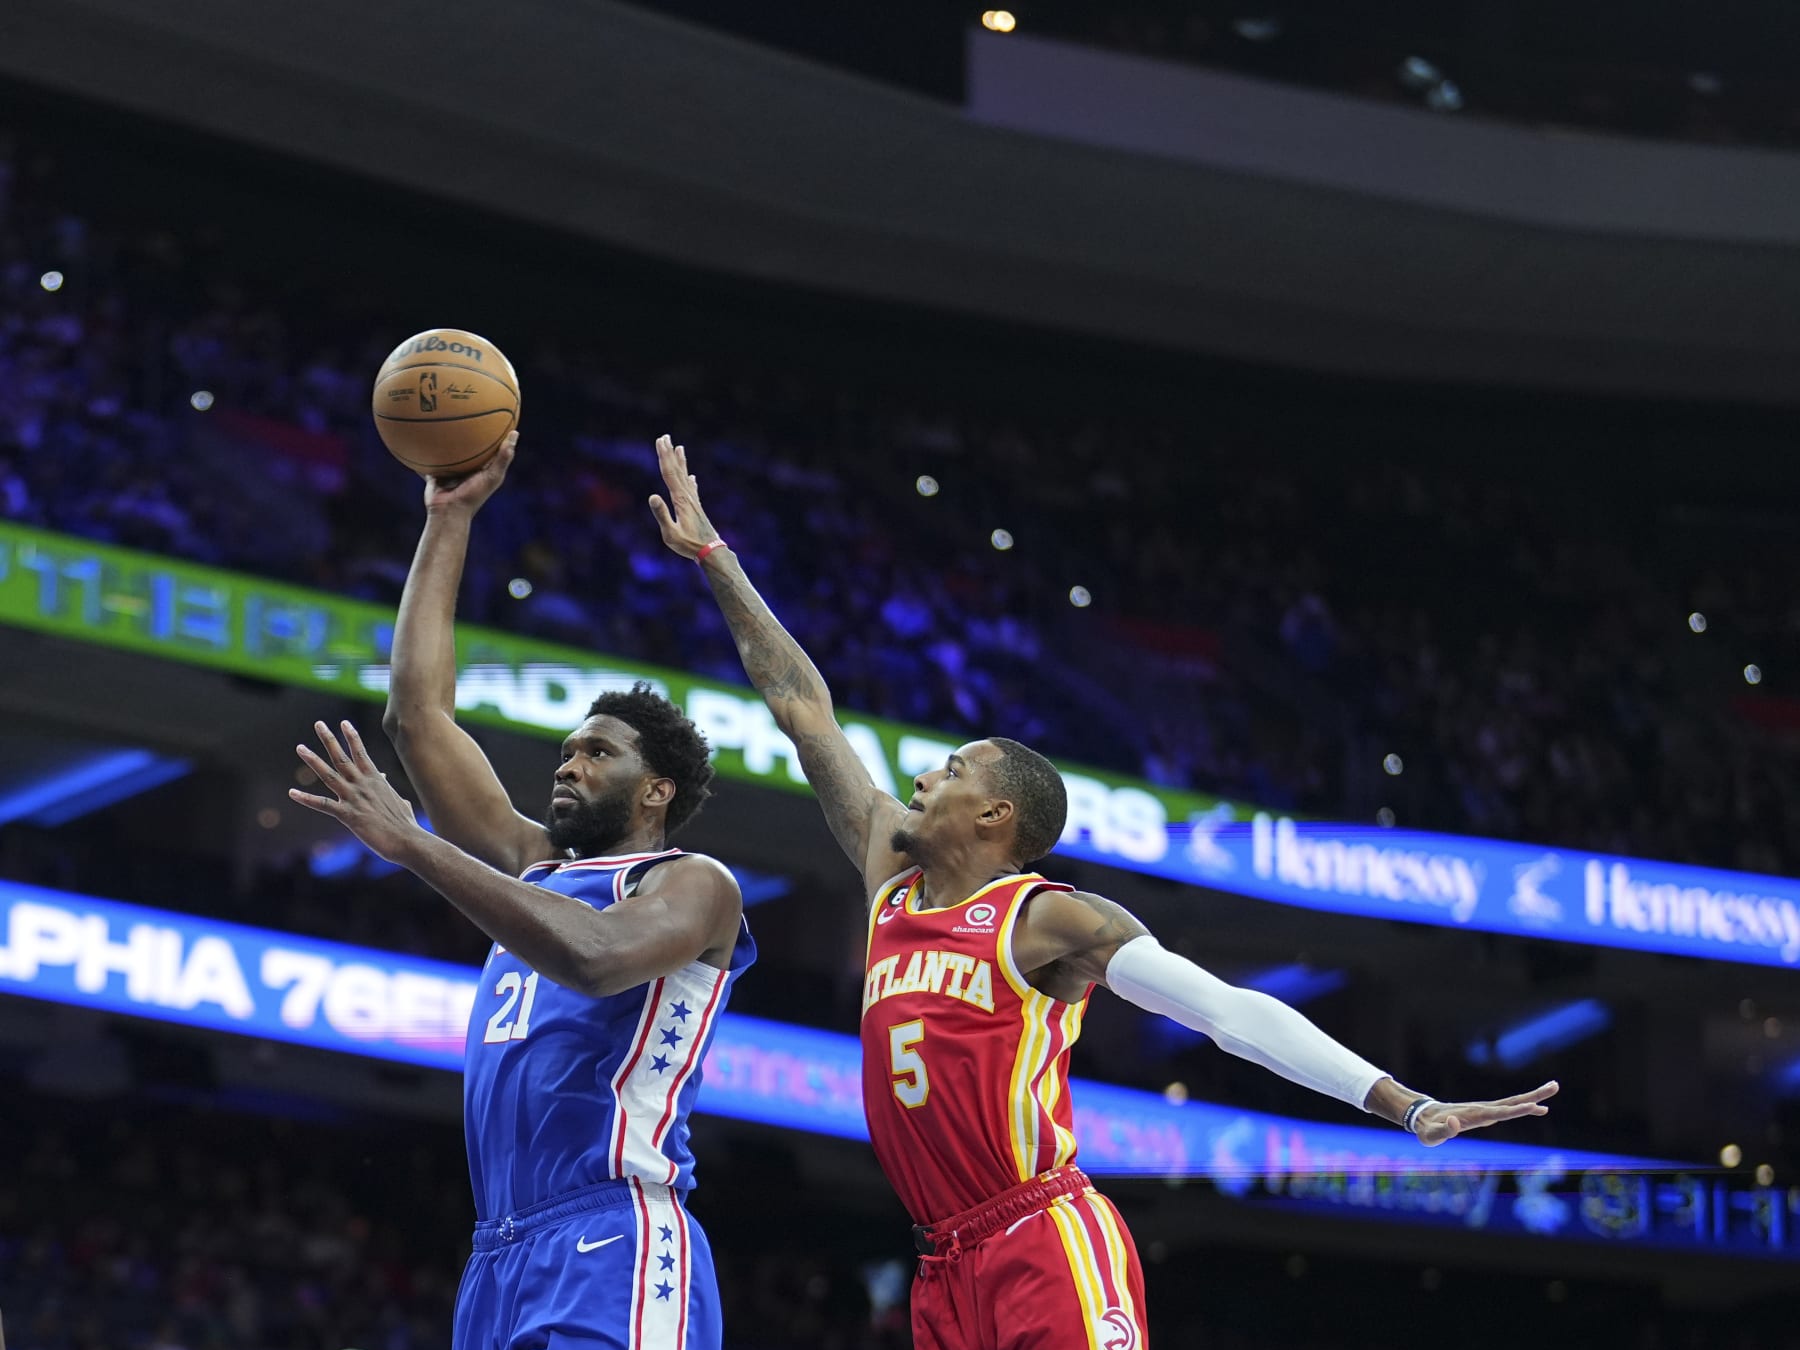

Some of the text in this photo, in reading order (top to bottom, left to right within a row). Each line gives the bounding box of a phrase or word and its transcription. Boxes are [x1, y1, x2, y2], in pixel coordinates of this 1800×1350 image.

[392, 336, 482, 362] Wilson
[891, 887, 909, 906] 6
[1252, 811, 1485, 923] Hennessy
[1584, 858, 1800, 963] Hennessy
[0, 902, 254, 1021] PHIA
[483, 970, 539, 1044] 21
[888, 1018, 930, 1110] 5
